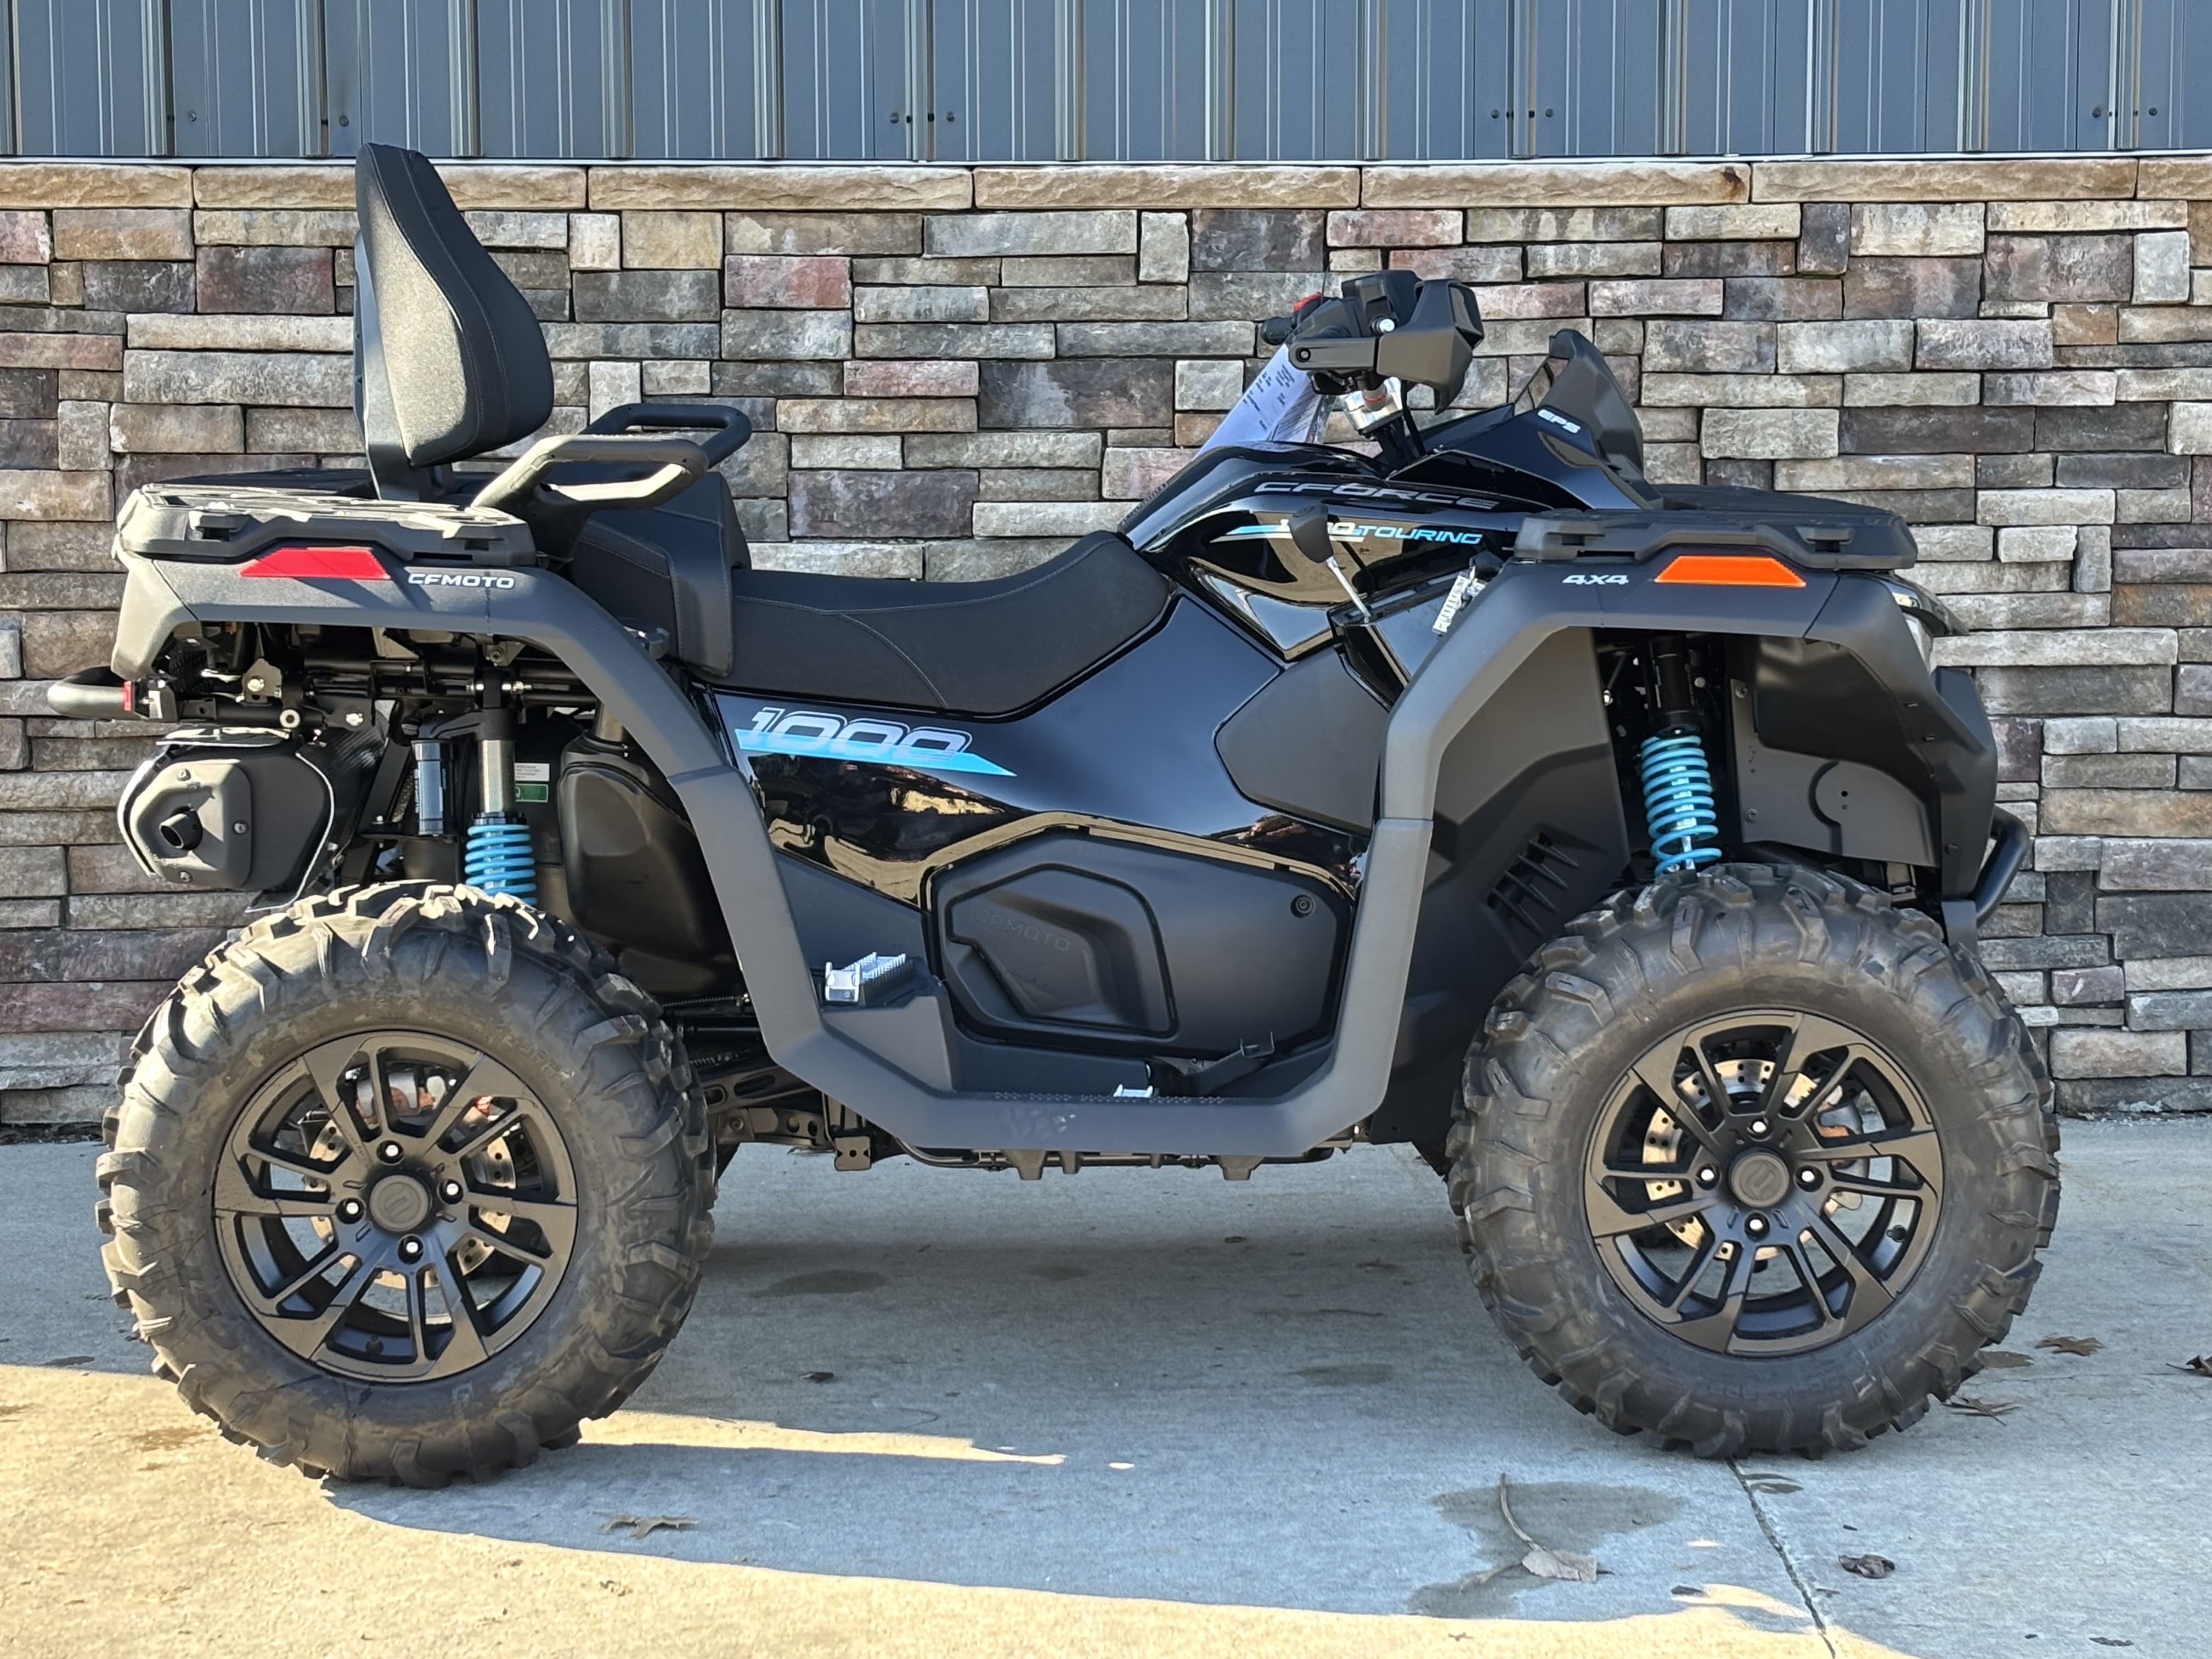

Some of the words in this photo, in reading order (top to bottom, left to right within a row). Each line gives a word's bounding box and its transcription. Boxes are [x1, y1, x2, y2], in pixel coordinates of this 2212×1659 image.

[1537, 409, 1581, 433] EPS
[1254, 481, 1499, 510] CFORCE
[1358, 524, 1483, 545] TOURING
[408, 573, 515, 589] CFMOTO
[743, 707, 973, 763] 1000
[974, 908, 1071, 951] CFMOTO
